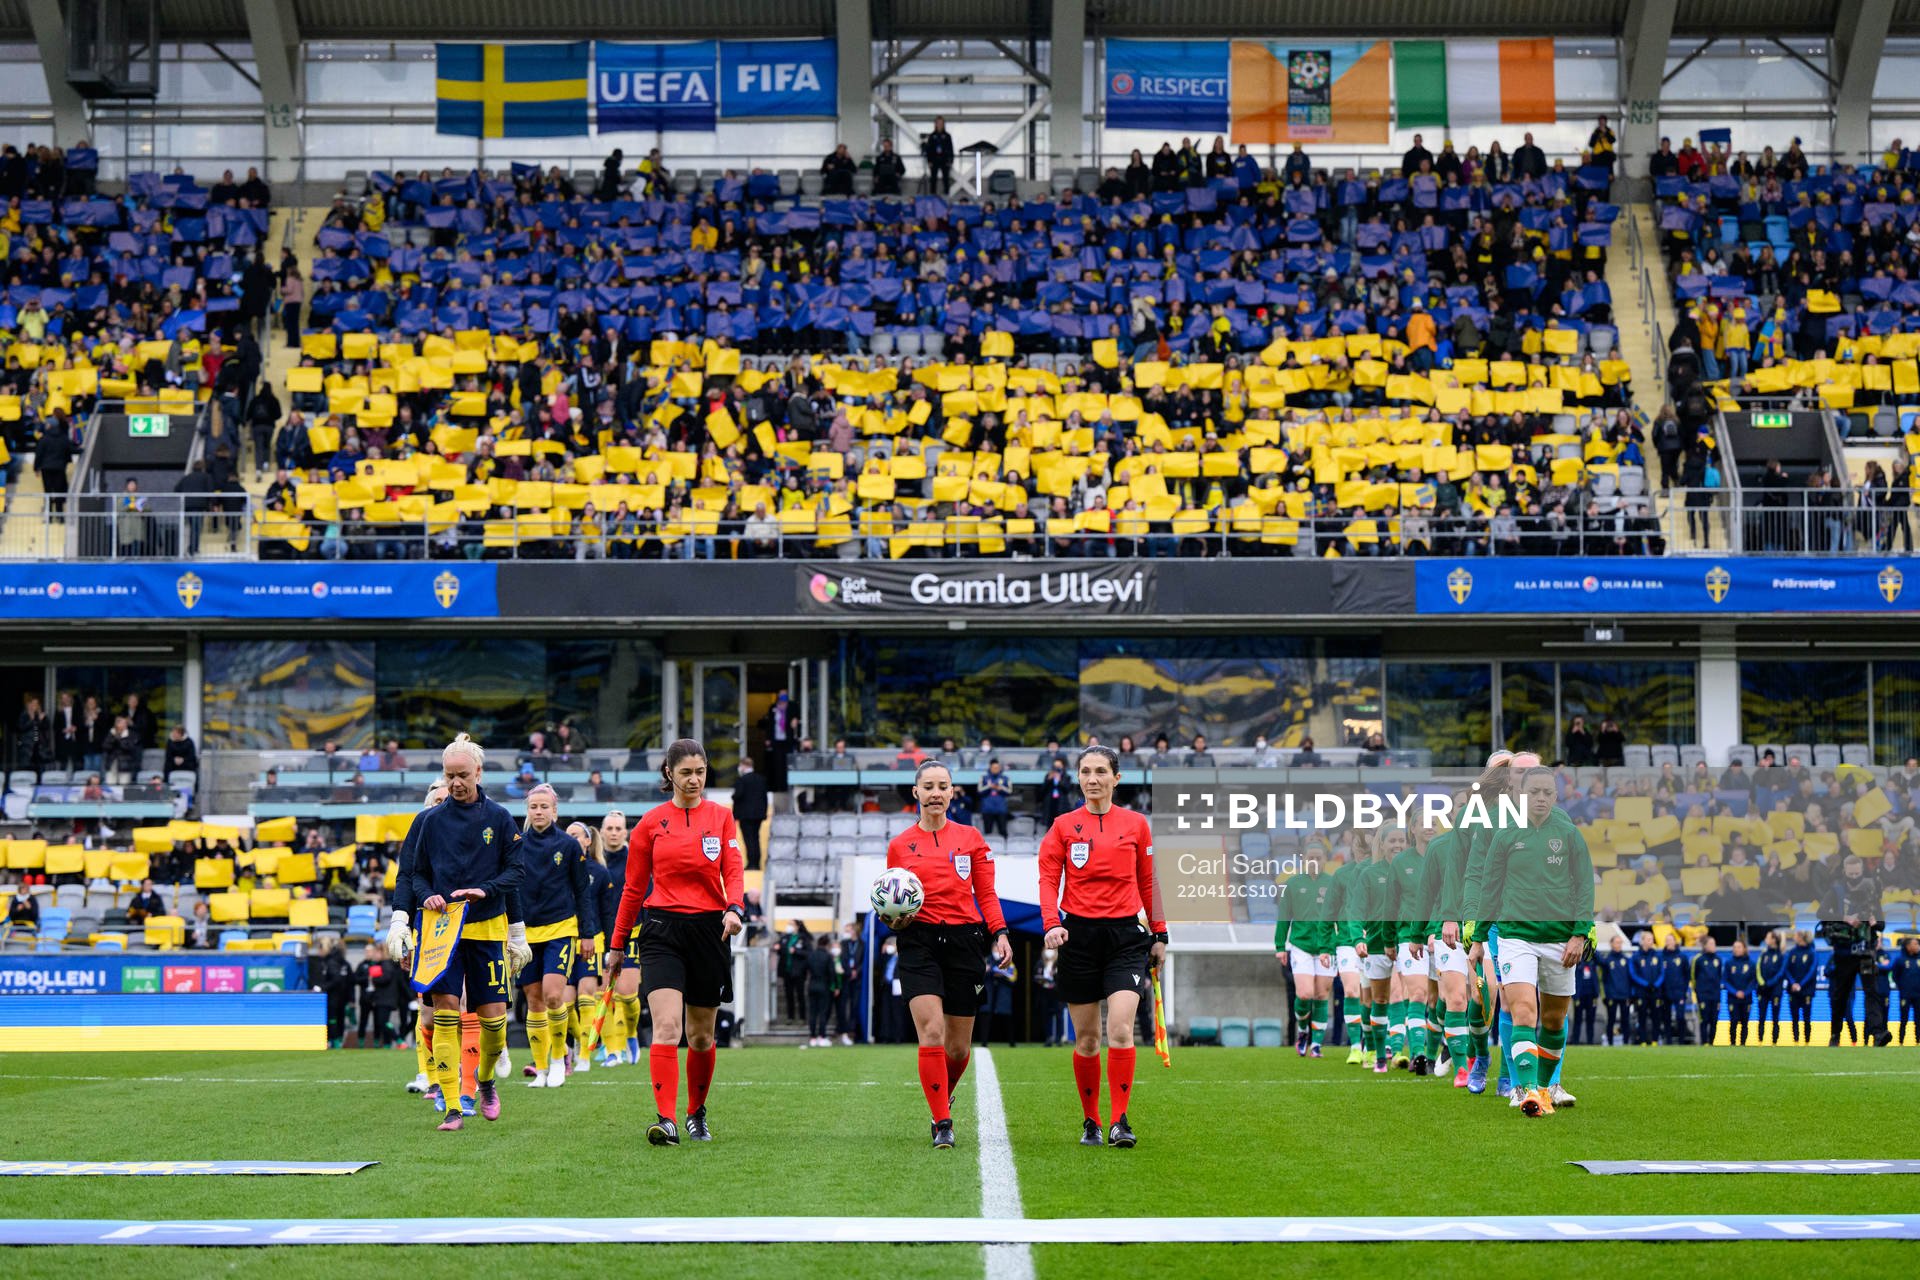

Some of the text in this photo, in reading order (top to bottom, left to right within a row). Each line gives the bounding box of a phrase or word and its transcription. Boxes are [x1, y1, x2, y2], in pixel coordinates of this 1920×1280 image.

[600, 71, 710, 102] UEFA
[736, 63, 821, 93] FIFA
[1140, 76, 1227, 97] RESPECT
[1631, 100, 1655, 111] N4
[1630, 111, 1654, 125] N5
[841, 576, 868, 591] Got
[910, 571, 1144, 604] Gamla Ullevi
[842, 590, 882, 604] Event
[1595, 629, 1613, 641] M5
[1546, 855, 1564, 866] sky
[558, 944, 569, 964] 4
[0, 970, 95, 987] TBOLLEN
[99, 970, 107, 987] I
[487, 960, 506, 987] 17
